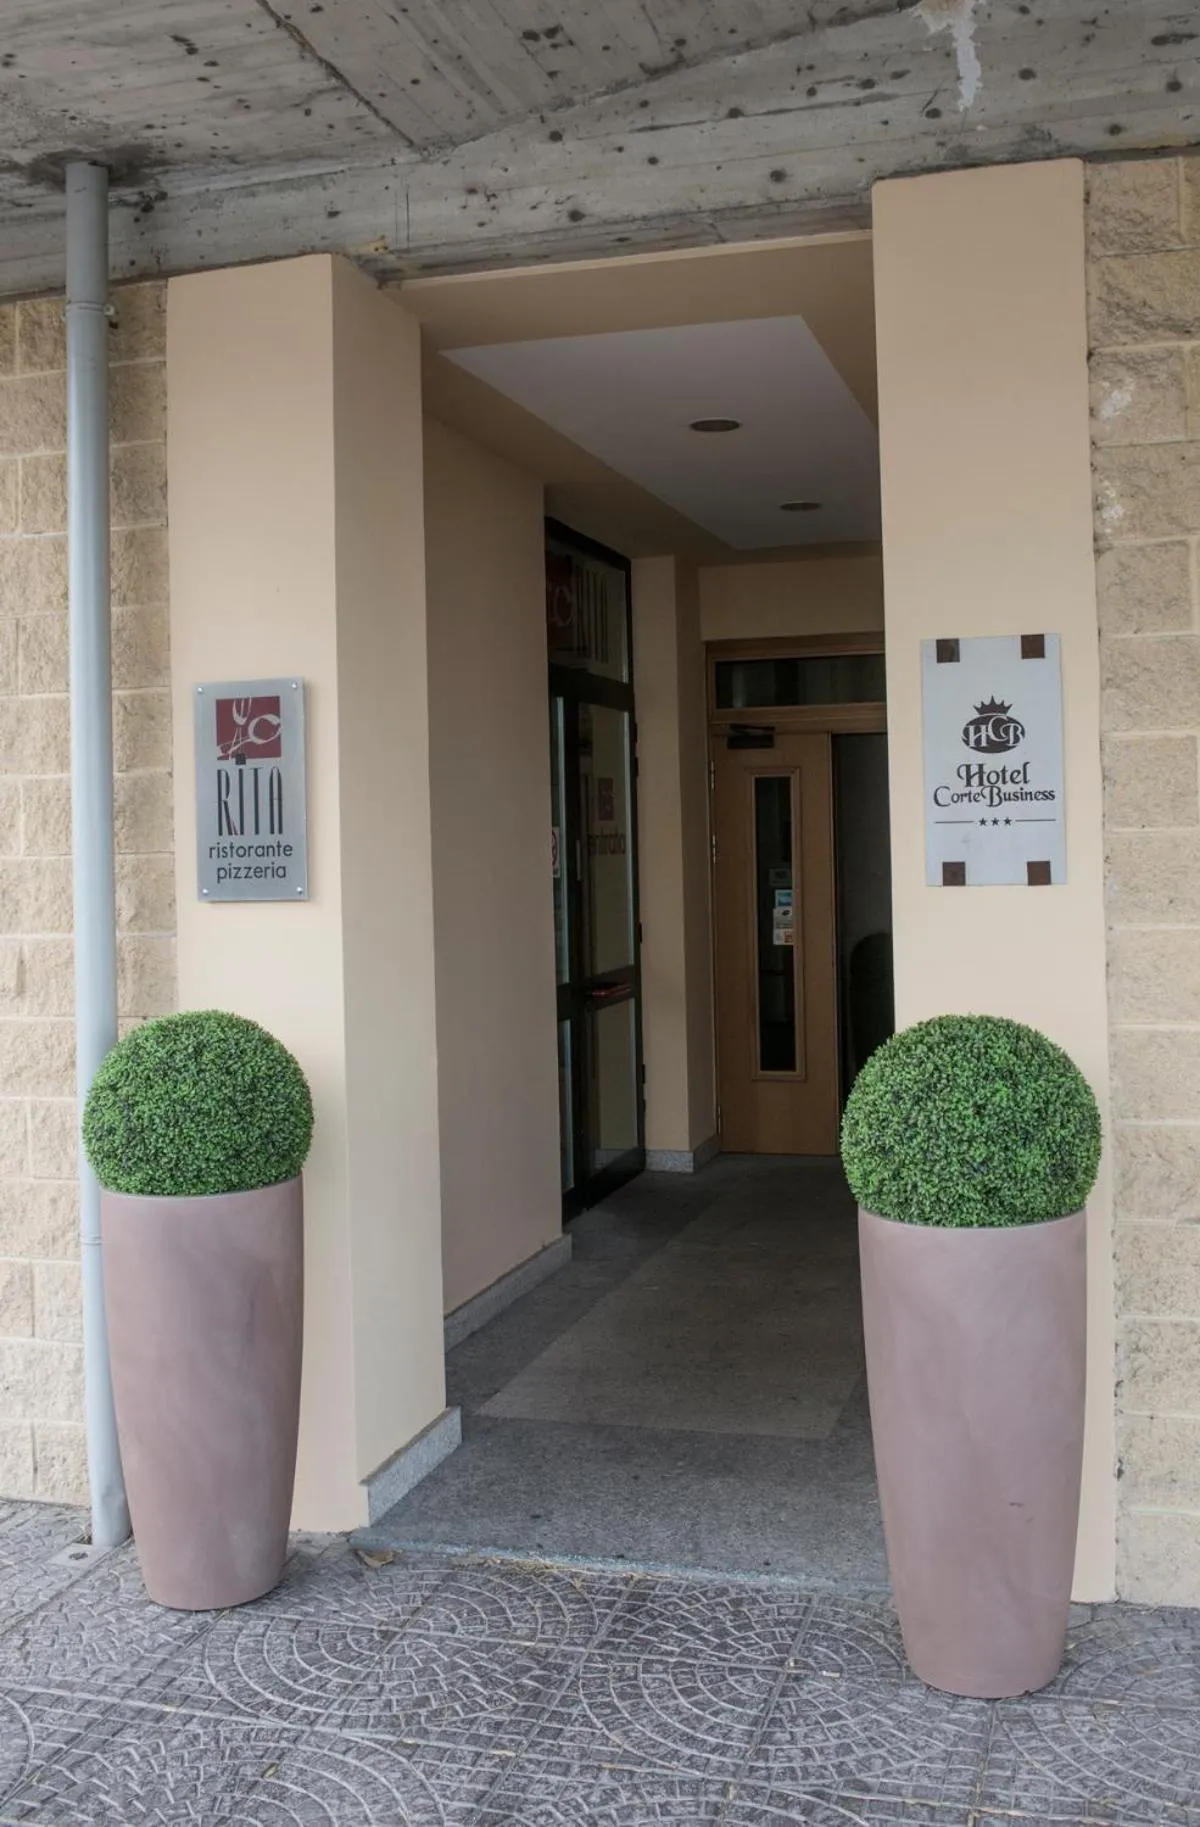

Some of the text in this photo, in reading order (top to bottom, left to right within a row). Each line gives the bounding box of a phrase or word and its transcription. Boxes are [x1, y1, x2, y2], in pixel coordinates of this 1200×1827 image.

[963, 715, 1025, 748] HCB
[957, 762, 1031, 788] Hotel
[217, 766, 283, 836] RITA
[209, 841, 293, 859] ristorante
[216, 862, 287, 884] pizzeria
